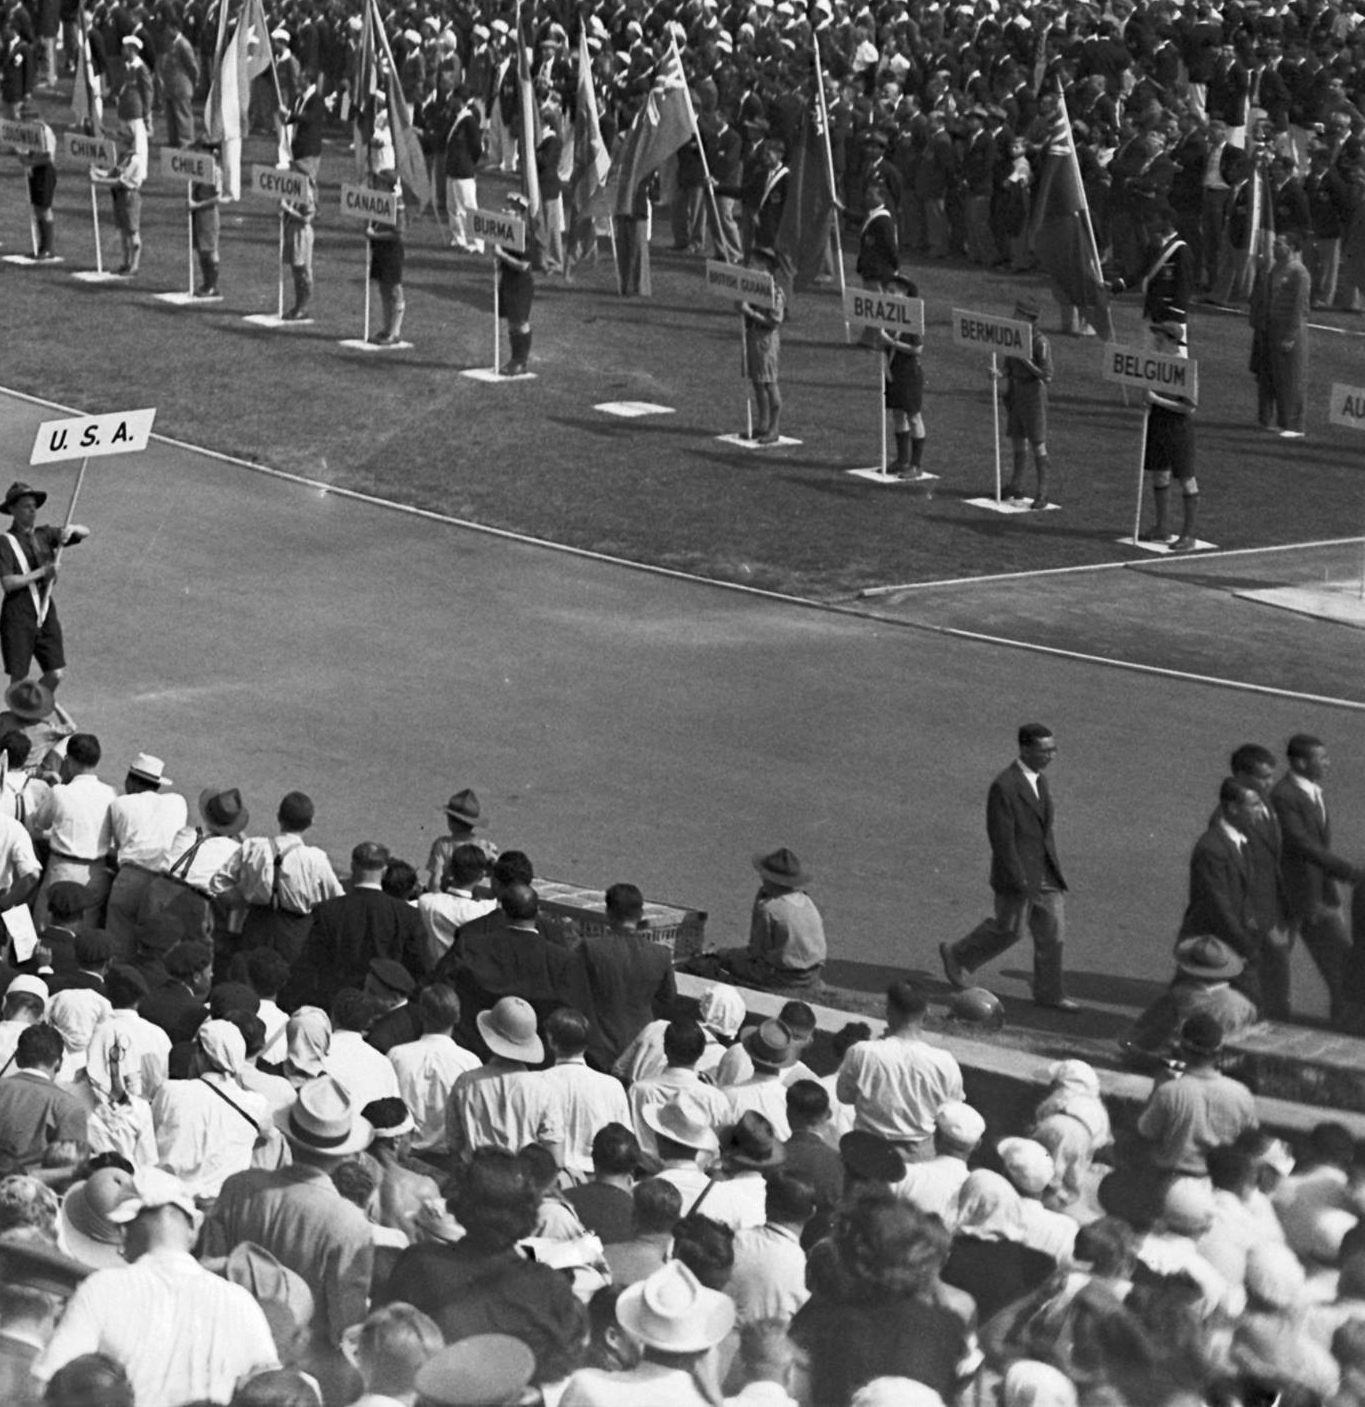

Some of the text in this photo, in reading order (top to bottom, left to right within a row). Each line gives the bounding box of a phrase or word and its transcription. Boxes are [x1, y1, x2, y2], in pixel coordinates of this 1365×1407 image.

[71, 140, 108, 161] CHINA
[171, 156, 204, 176] CHILE
[259, 172, 302, 195] CEYLON
[346, 191, 390, 217] CANADA
[473, 215, 515, 242] BURMA
[854, 297, 912, 324] BRAZIL
[961, 318, 1023, 348] BERMUDA
[1113, 352, 1186, 386] BELGIUM
